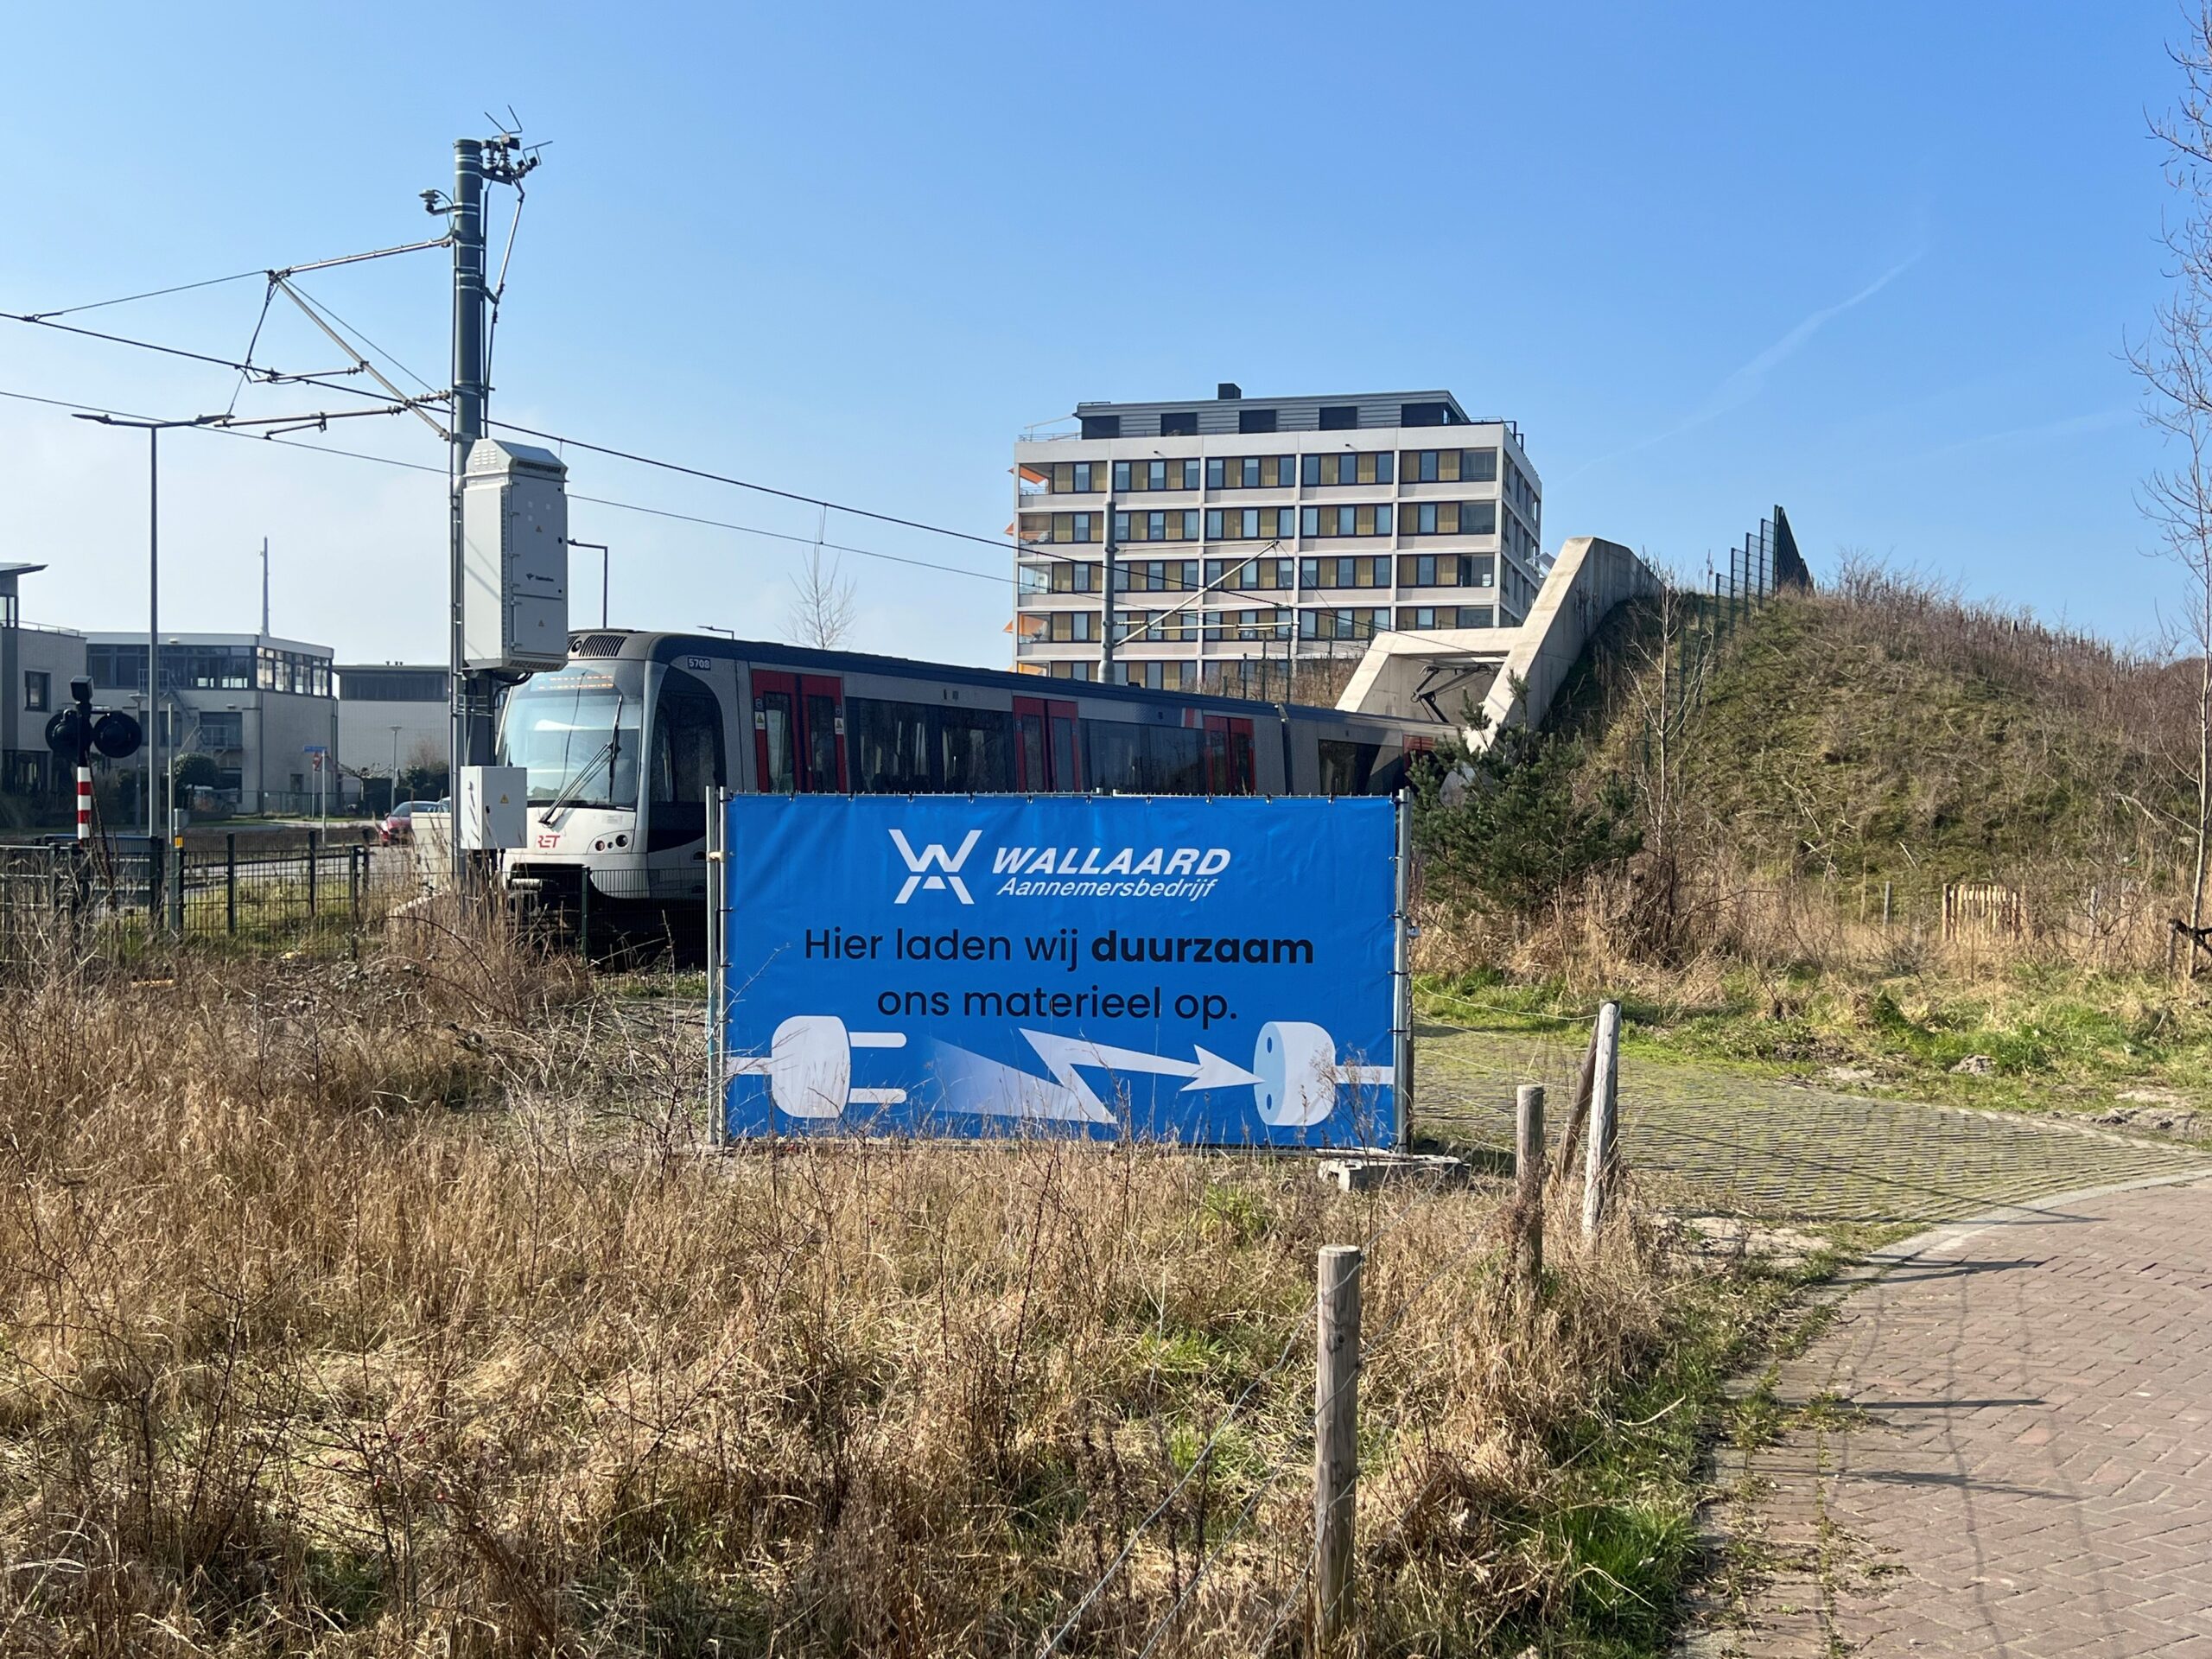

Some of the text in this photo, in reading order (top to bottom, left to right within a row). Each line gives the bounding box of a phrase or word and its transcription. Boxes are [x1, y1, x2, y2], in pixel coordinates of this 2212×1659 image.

[688, 658, 710, 669] 5708
[992, 847, 1231, 875] WALLAARD
[996, 877, 1218, 902] Aannemersbedrijf
[805, 925, 1314, 973] Hier laden wij duurzaam
[877, 984, 1237, 1029] ons materieel op.
